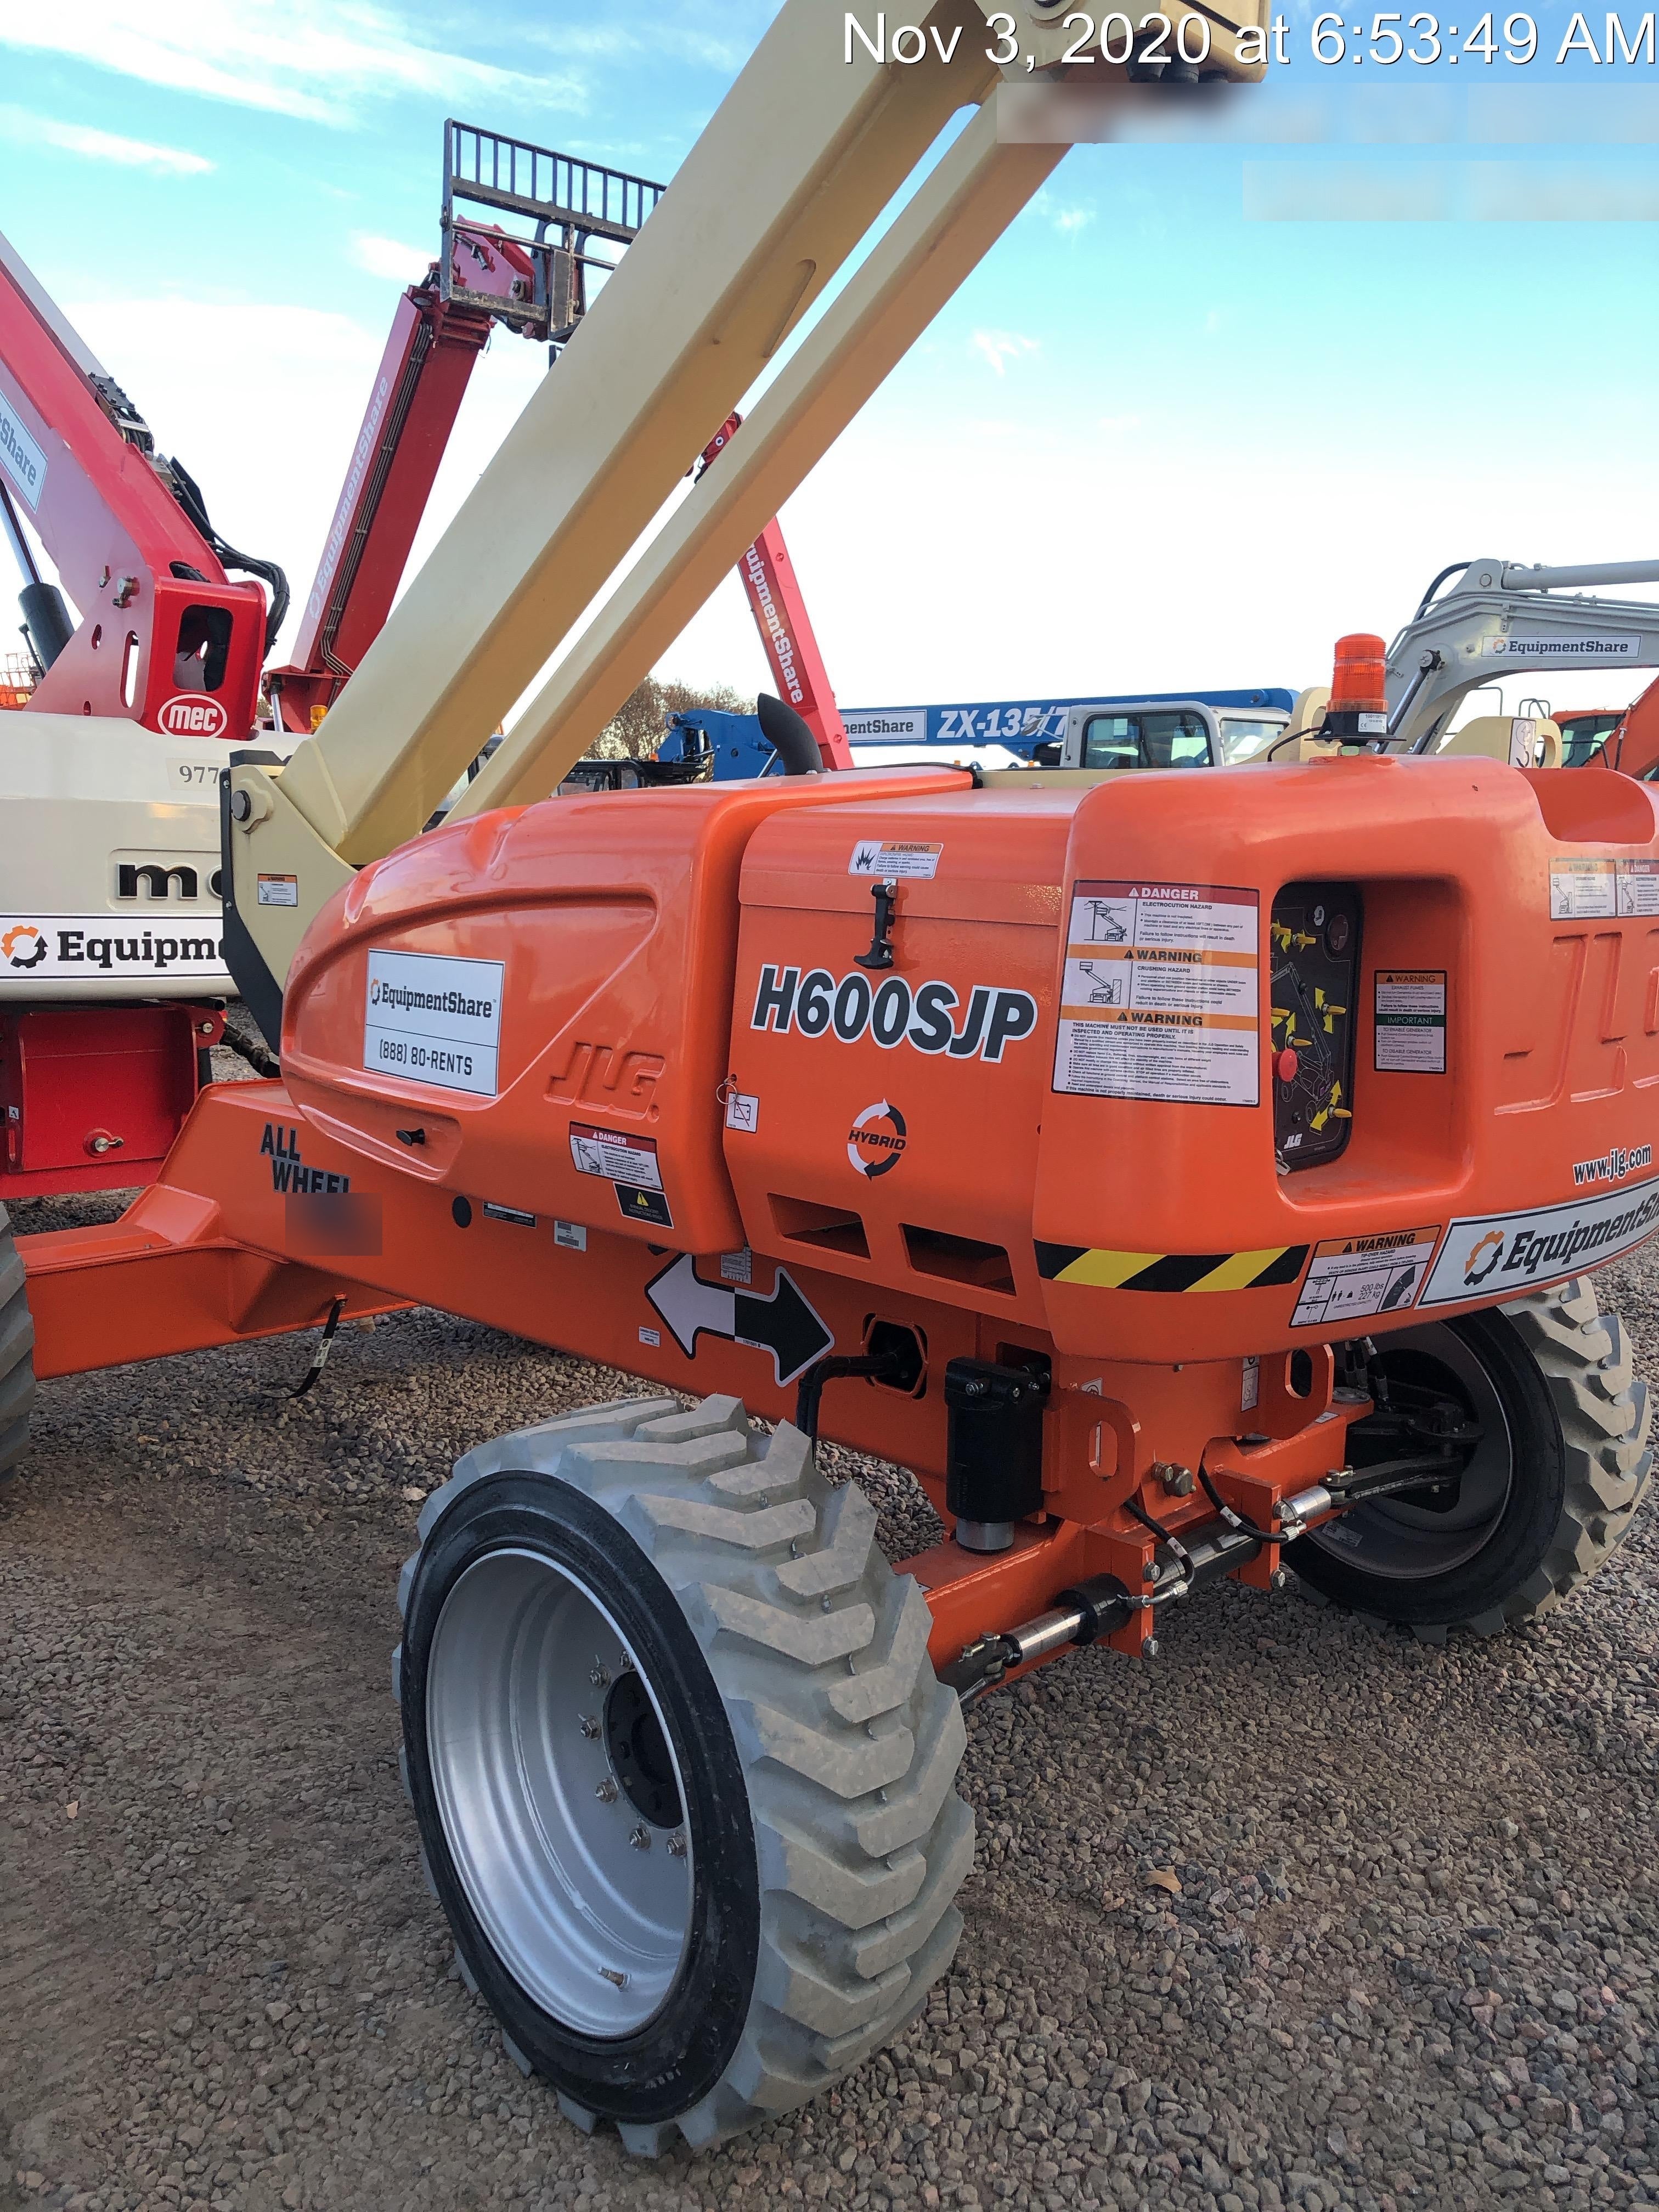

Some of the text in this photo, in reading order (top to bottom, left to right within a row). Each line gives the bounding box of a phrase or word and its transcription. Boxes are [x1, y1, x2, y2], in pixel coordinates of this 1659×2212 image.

[0, 413, 37, 487] Share
[317, 377, 387, 595] EquipmentShare
[746, 543, 803, 703] uipmentShare
[1509, 641, 1628, 654] EquipmentShare
[168, 705, 218, 731] mec
[1142, 888, 1199, 900] DANGER
[1137, 950, 1203, 963] WARNING
[382, 983, 492, 1018] EquipmentShare
[752, 966, 1036, 1061] H600SJP
[1131, 1012, 1203, 1026] WARNING
[1387, 1016, 1432, 1024] IMPORTANT
[380, 1039, 472, 1075] (888) 80-RENTS
[259, 1123, 301, 1162] ALL
[599, 1132, 627, 1146] DANGER
[848, 1130, 906, 1150] HYBRID
[1284, 1133, 1302, 1149] JLG
[1573, 1144, 1651, 1185] www.jlg.com
[1356, 1233, 1415, 1251] WARNING
[1358, 1291, 1380, 1300] 227 kg
